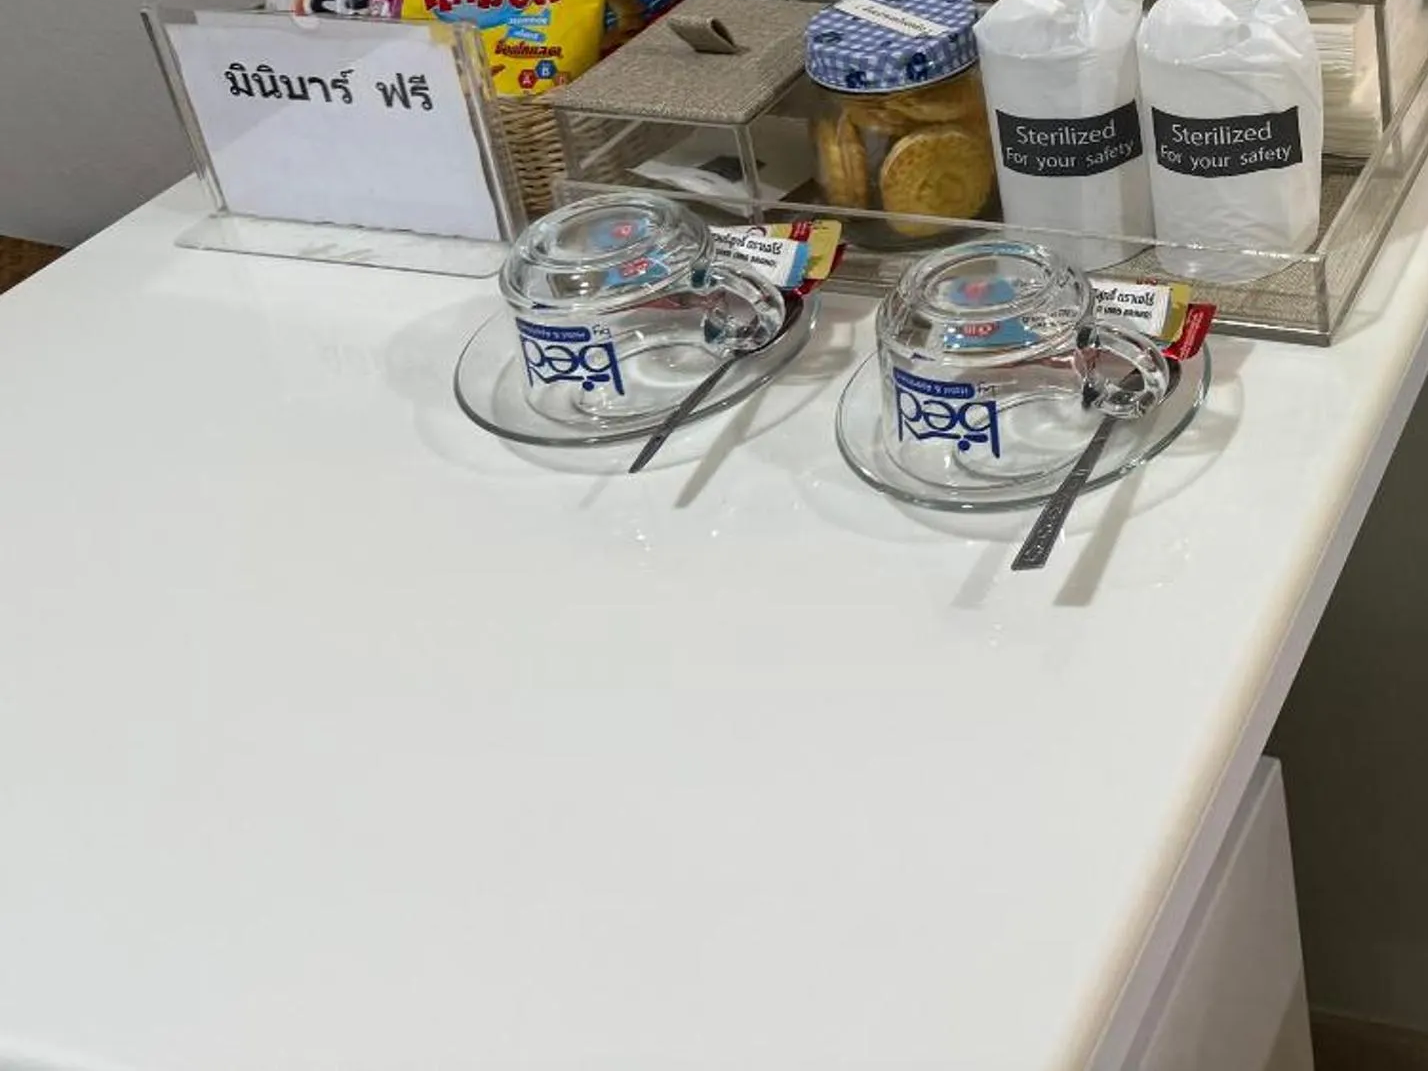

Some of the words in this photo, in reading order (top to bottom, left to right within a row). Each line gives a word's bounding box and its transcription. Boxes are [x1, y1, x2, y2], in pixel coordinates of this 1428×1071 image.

[224, 62, 355, 105] มินิบาร์
[375, 72, 434, 111] ฟรี
[1016, 119, 1116, 146] Sterilized
[1171, 120, 1273, 146] Sterilized
[1006, 147, 1028, 165] For
[1036, 155, 1076, 171] your
[1086, 141, 1135, 166] safety
[1160, 146, 1183, 164] For
[1190, 154, 1231, 171] your
[1240, 145, 1292, 165] safety
[519, 334, 625, 396] bed
[895, 385, 1001, 459] bed
